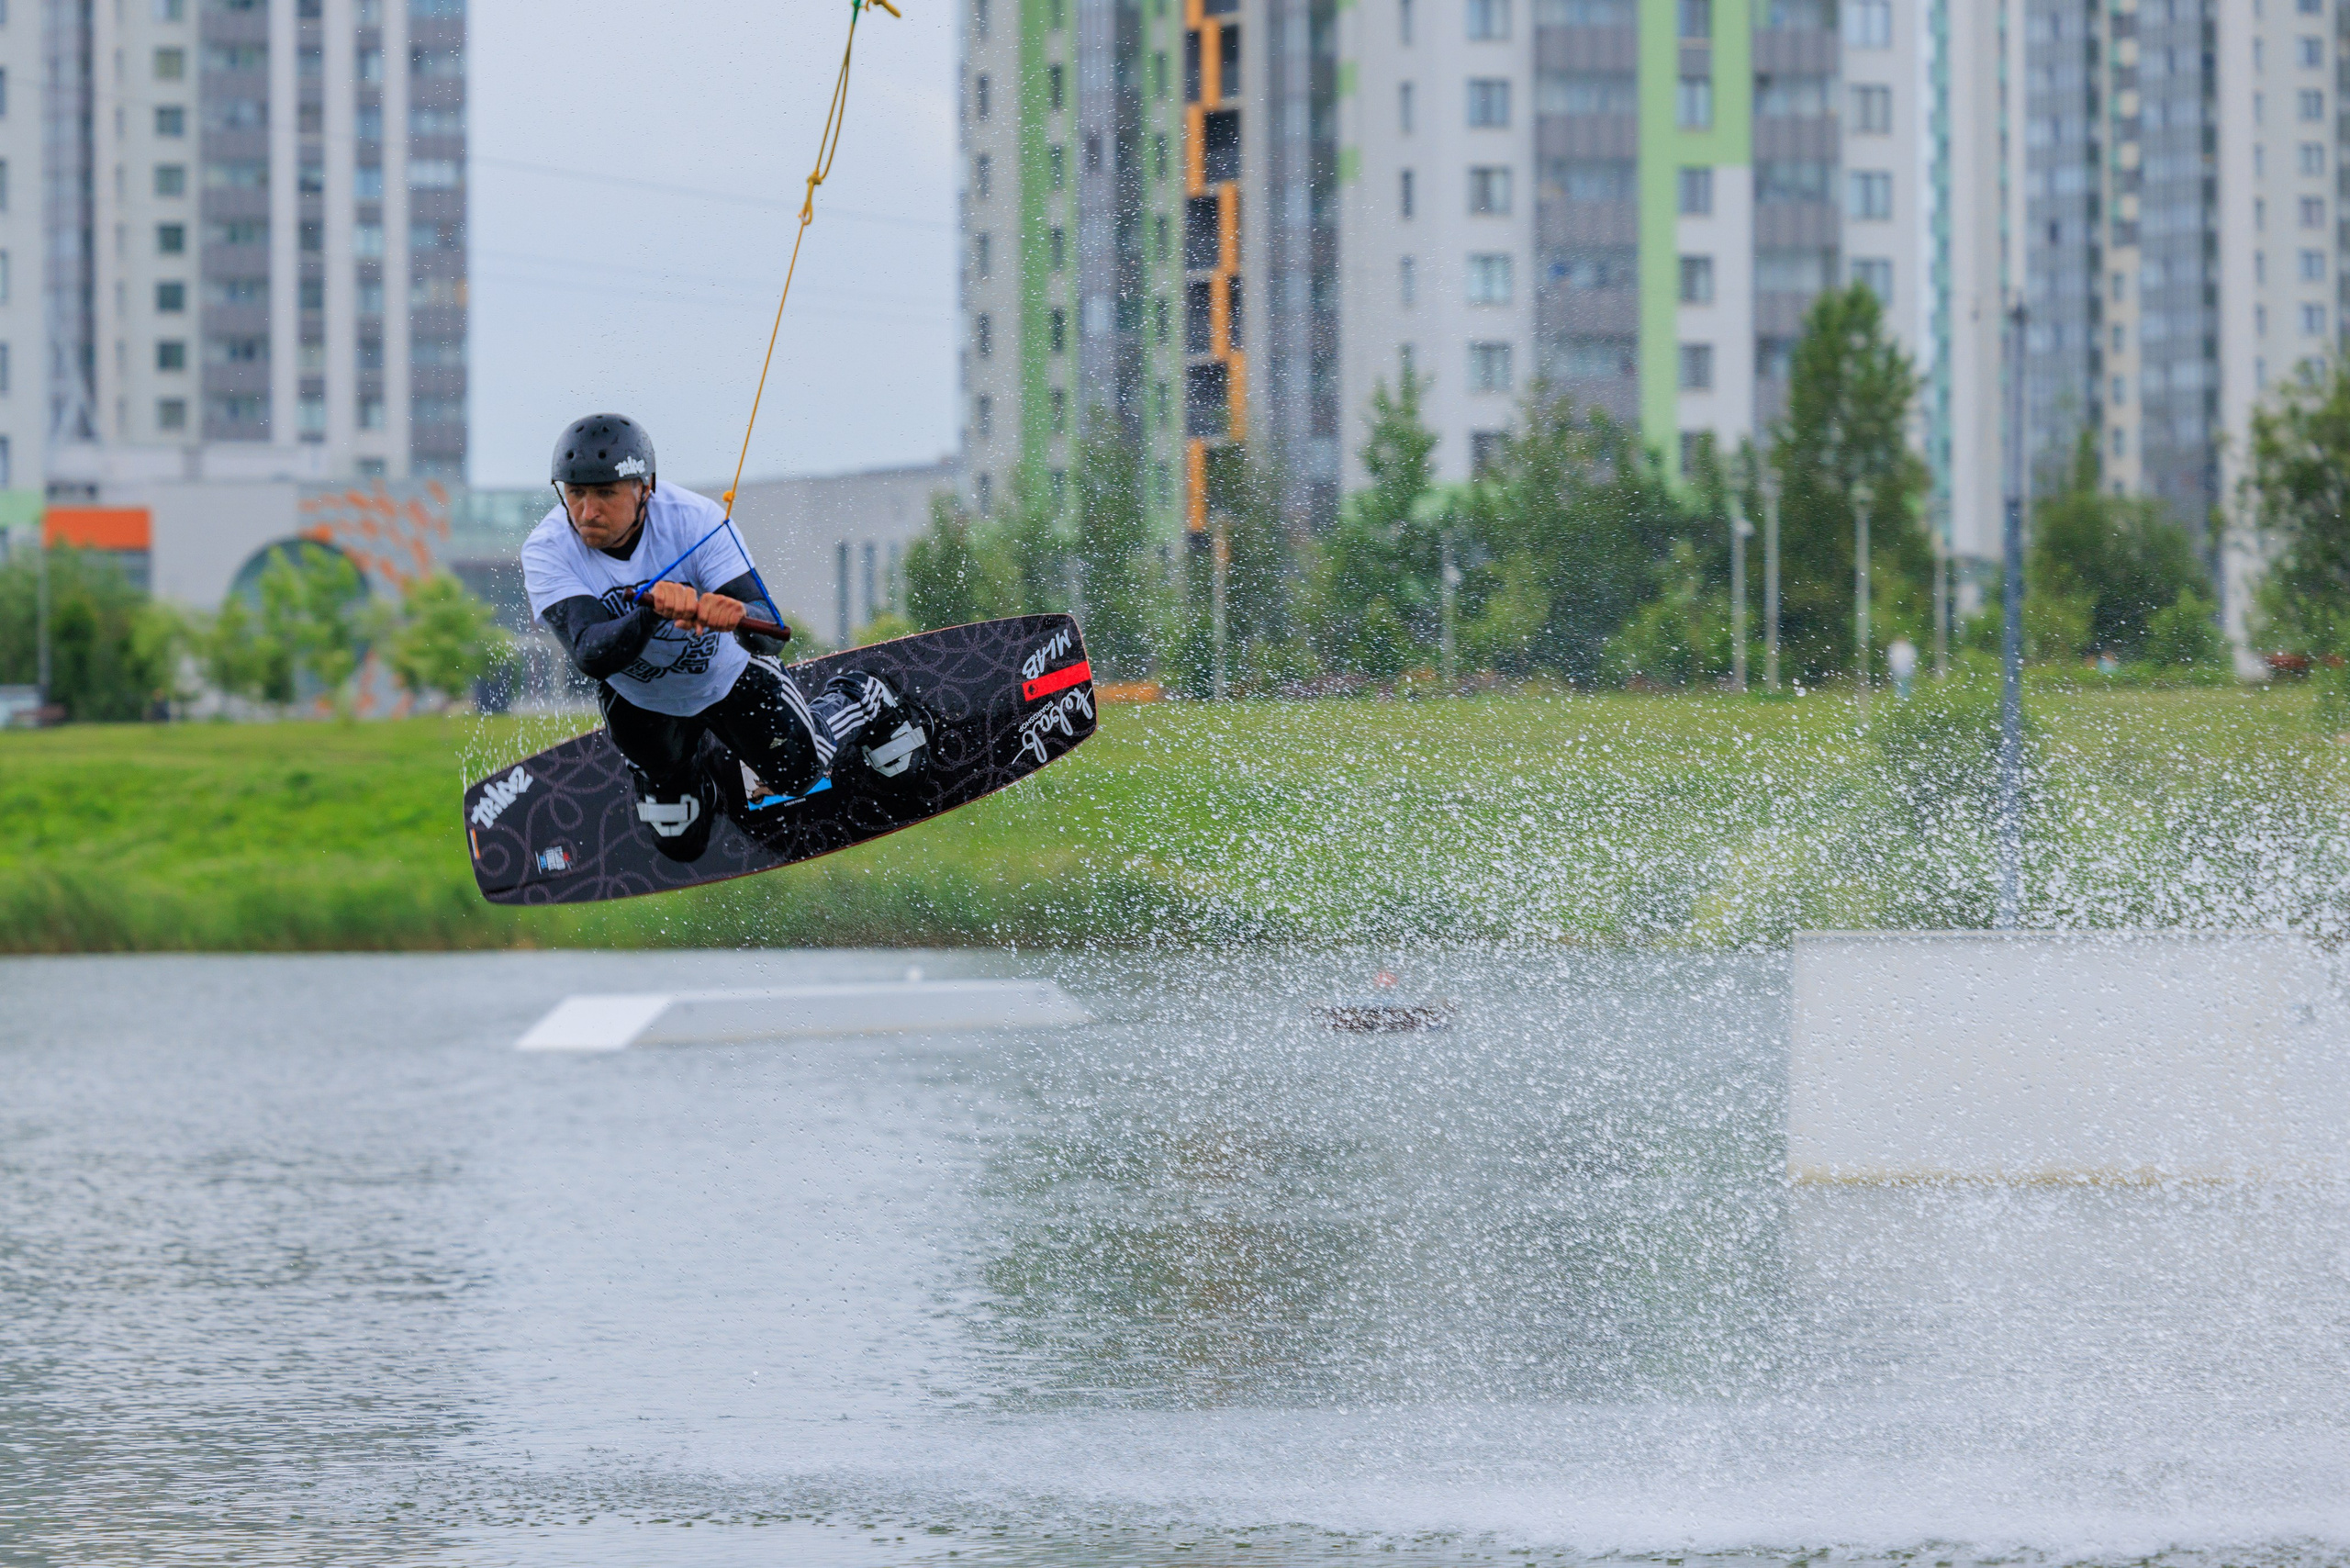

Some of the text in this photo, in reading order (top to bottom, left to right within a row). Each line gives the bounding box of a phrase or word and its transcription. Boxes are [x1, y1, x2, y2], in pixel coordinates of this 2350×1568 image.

[1022, 629, 1071, 679] MLAB
[1012, 687, 1093, 764] kebab
[1018, 700, 1054, 733] BOARDSHOP
